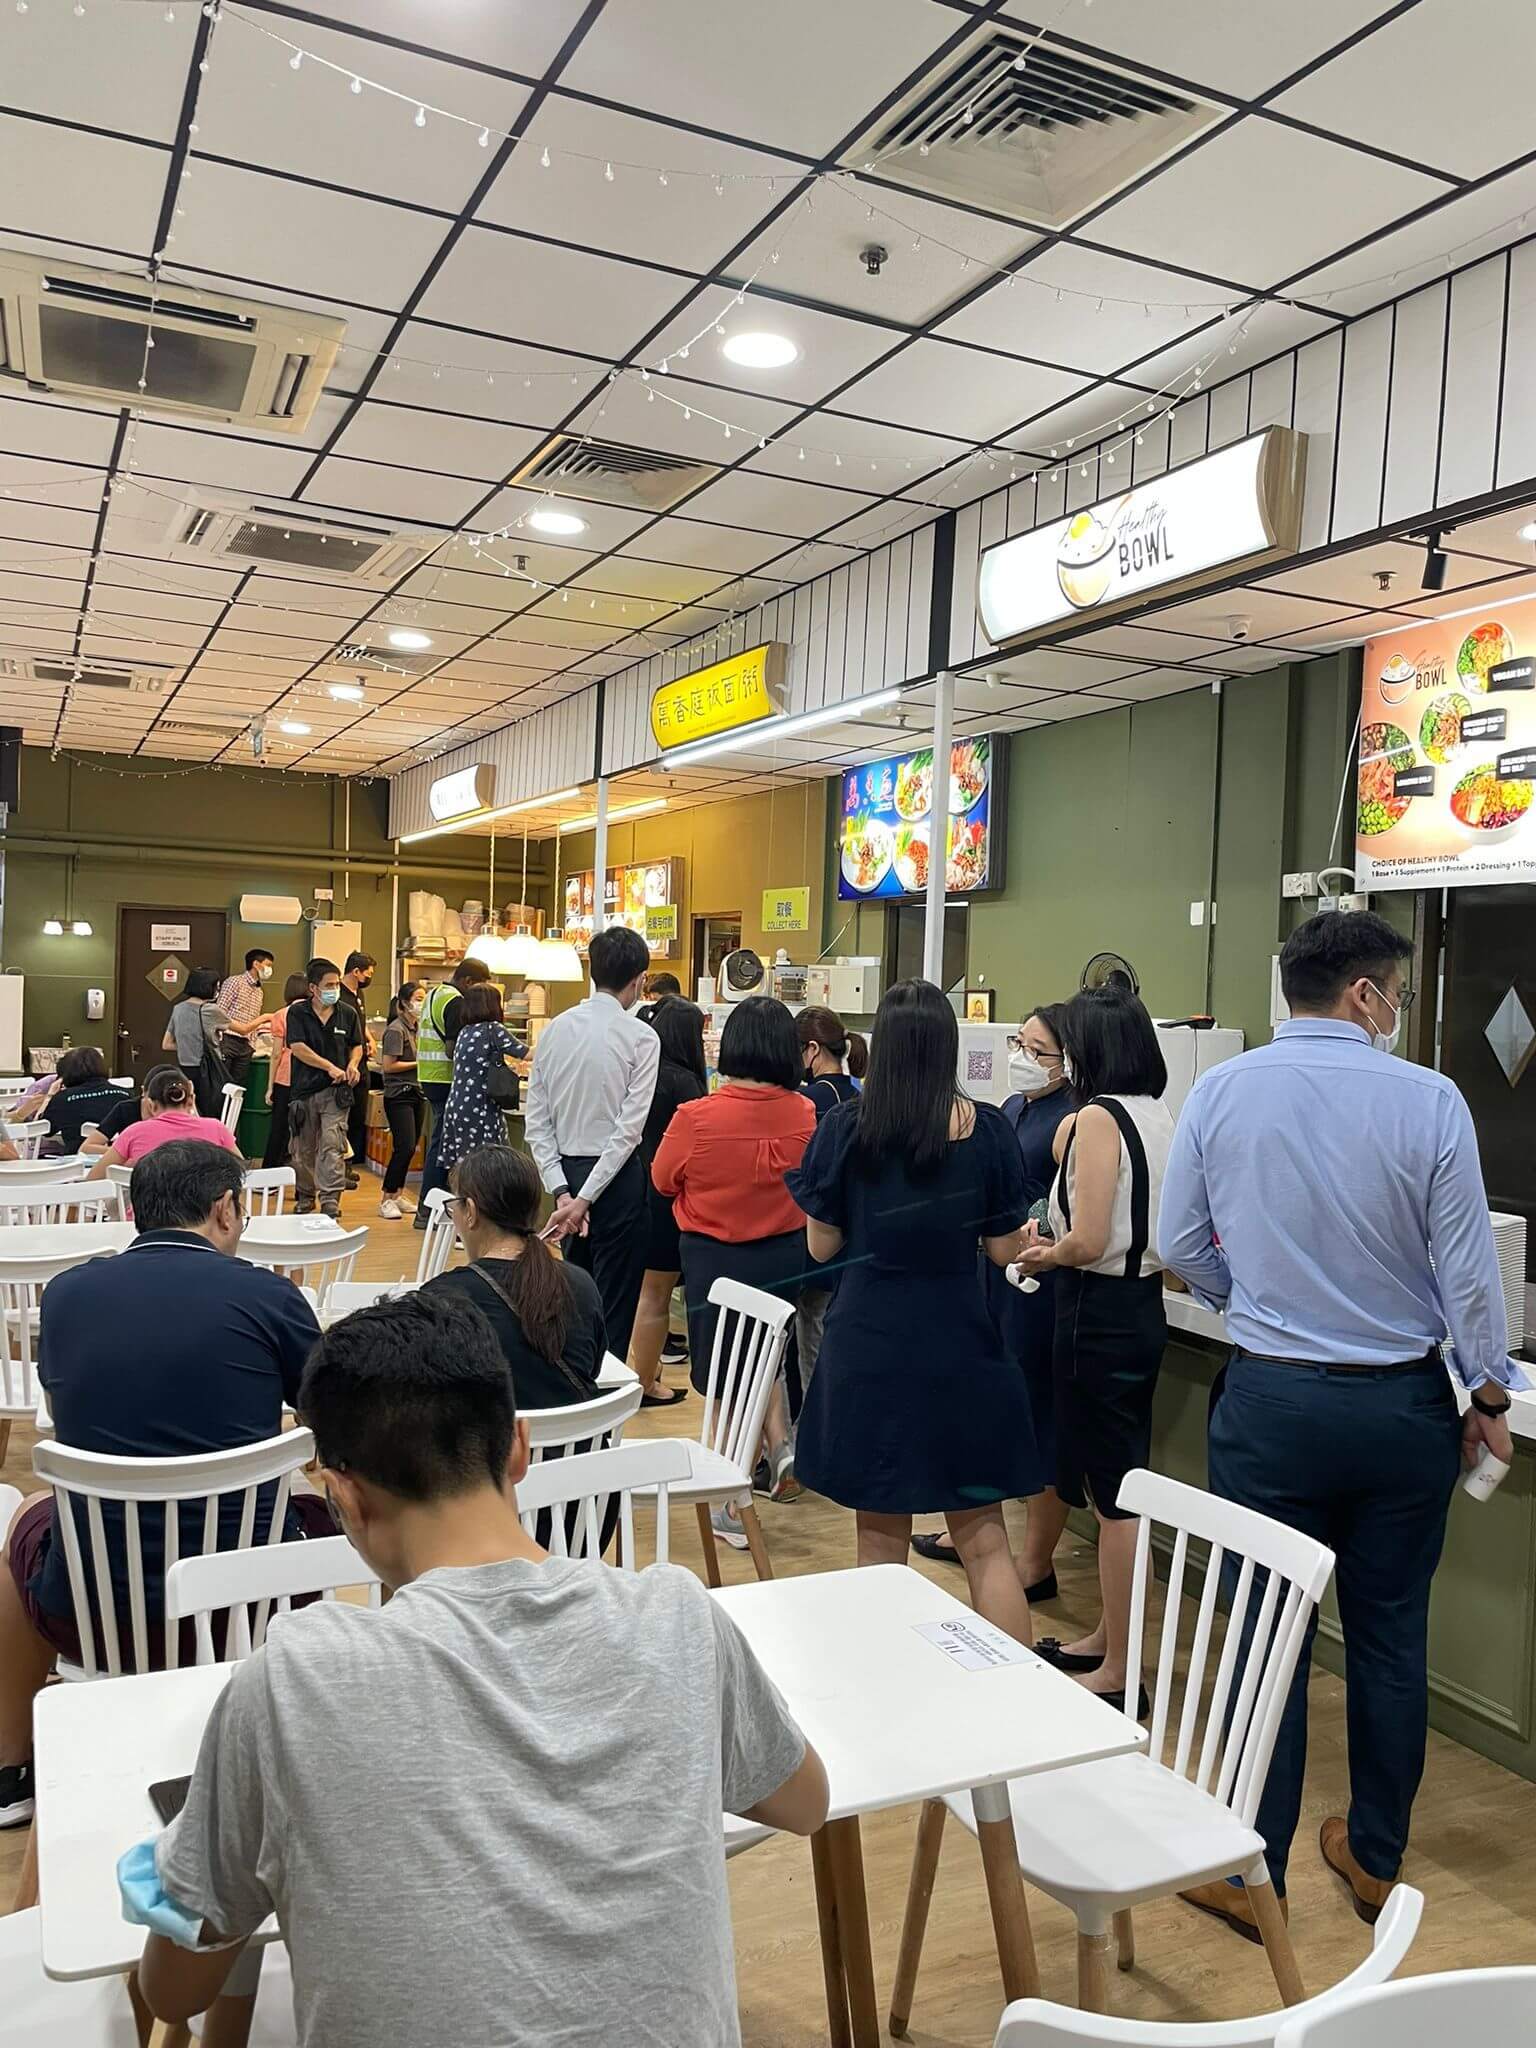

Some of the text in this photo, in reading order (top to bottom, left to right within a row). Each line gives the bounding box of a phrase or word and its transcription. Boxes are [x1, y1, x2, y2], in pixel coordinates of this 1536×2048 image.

[1119, 526, 1174, 577] BOWL
[1415, 668, 1447, 690] BOWL
[1371, 854, 1460, 868] CHOICE OF HEALTHY BOWL
[1400, 866, 1436, 876] Supplement
[1446, 864, 1470, 873] Protein
[1481, 861, 1511, 872] Dressing
[777, 901, 792, 917] 取餐
[767, 919, 801, 930] COLLECT HERE
